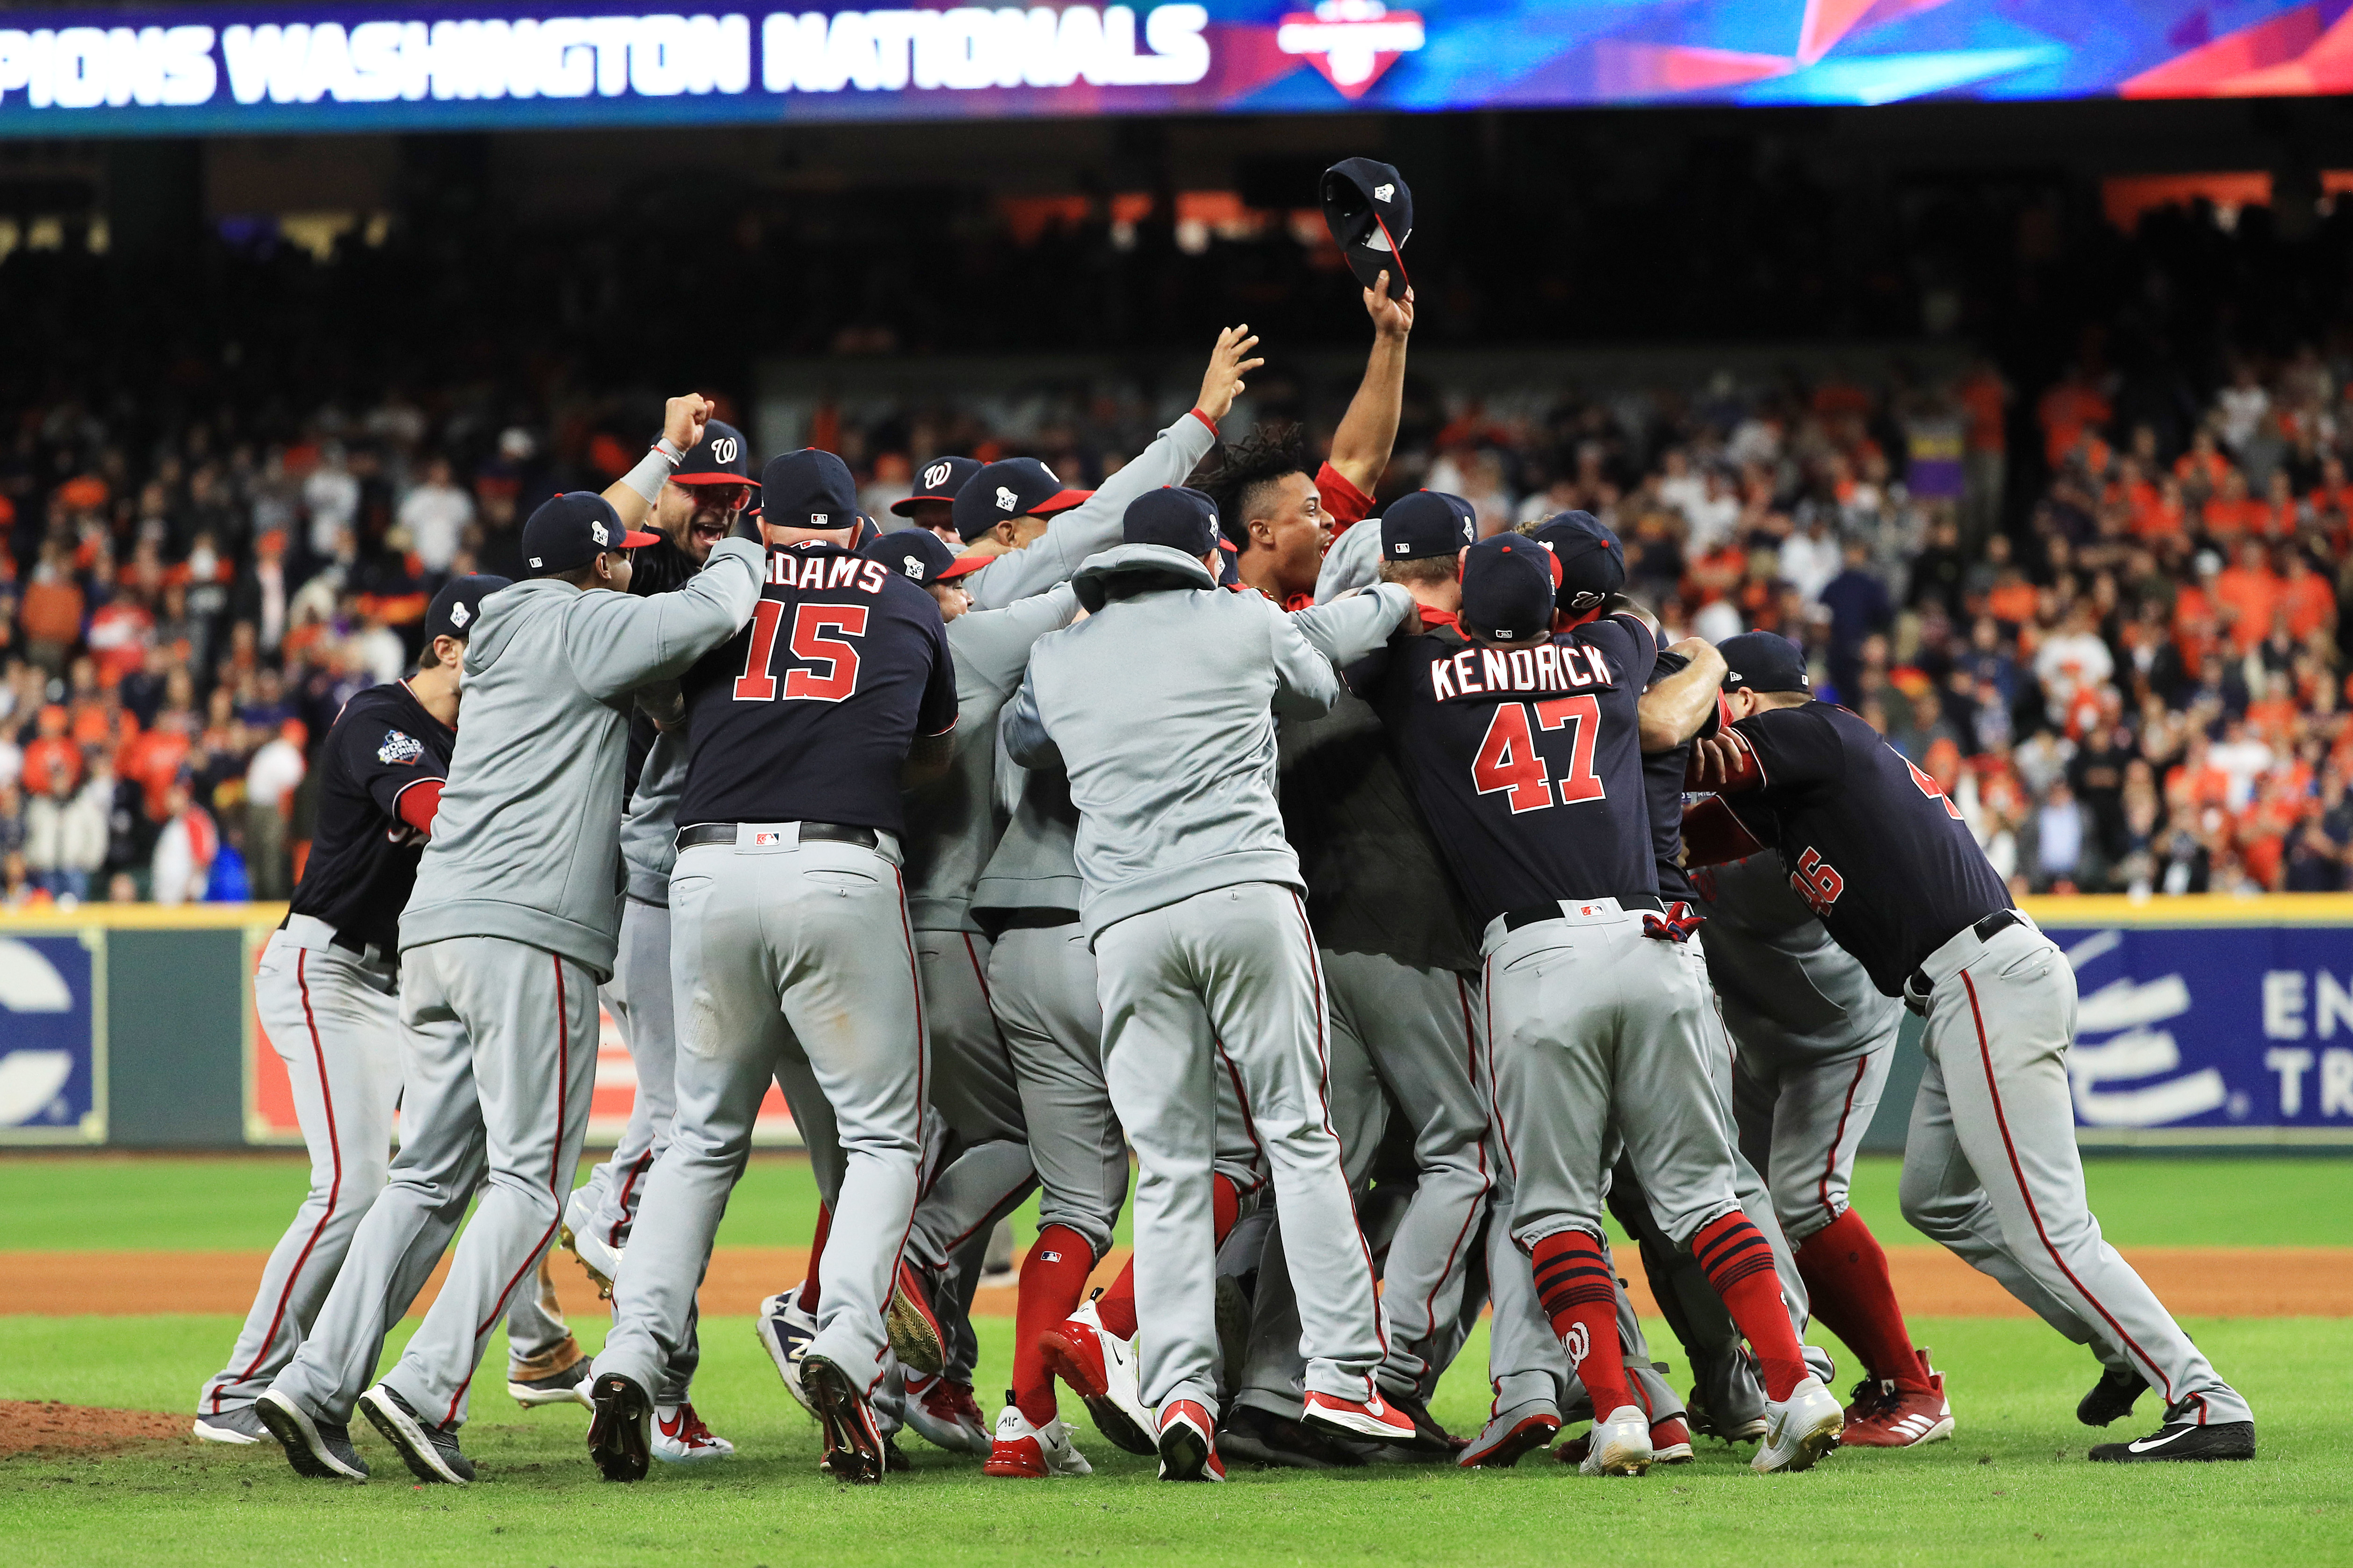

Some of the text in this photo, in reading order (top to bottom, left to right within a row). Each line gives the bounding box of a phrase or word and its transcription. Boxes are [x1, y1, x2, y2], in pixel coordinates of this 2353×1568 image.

[222, 14, 750, 103] WASHINGTON
[762, 4, 1211, 92] NATIONALS
[733, 598, 869, 702] 15
[1431, 643, 1612, 701] KENDRICK
[377, 739, 421, 757] WORLD
[384, 745, 424, 764] SERIES
[1471, 694, 1606, 815] 47
[2261, 969, 2353, 1041] EN
[2264, 1047, 2353, 1117] TR
